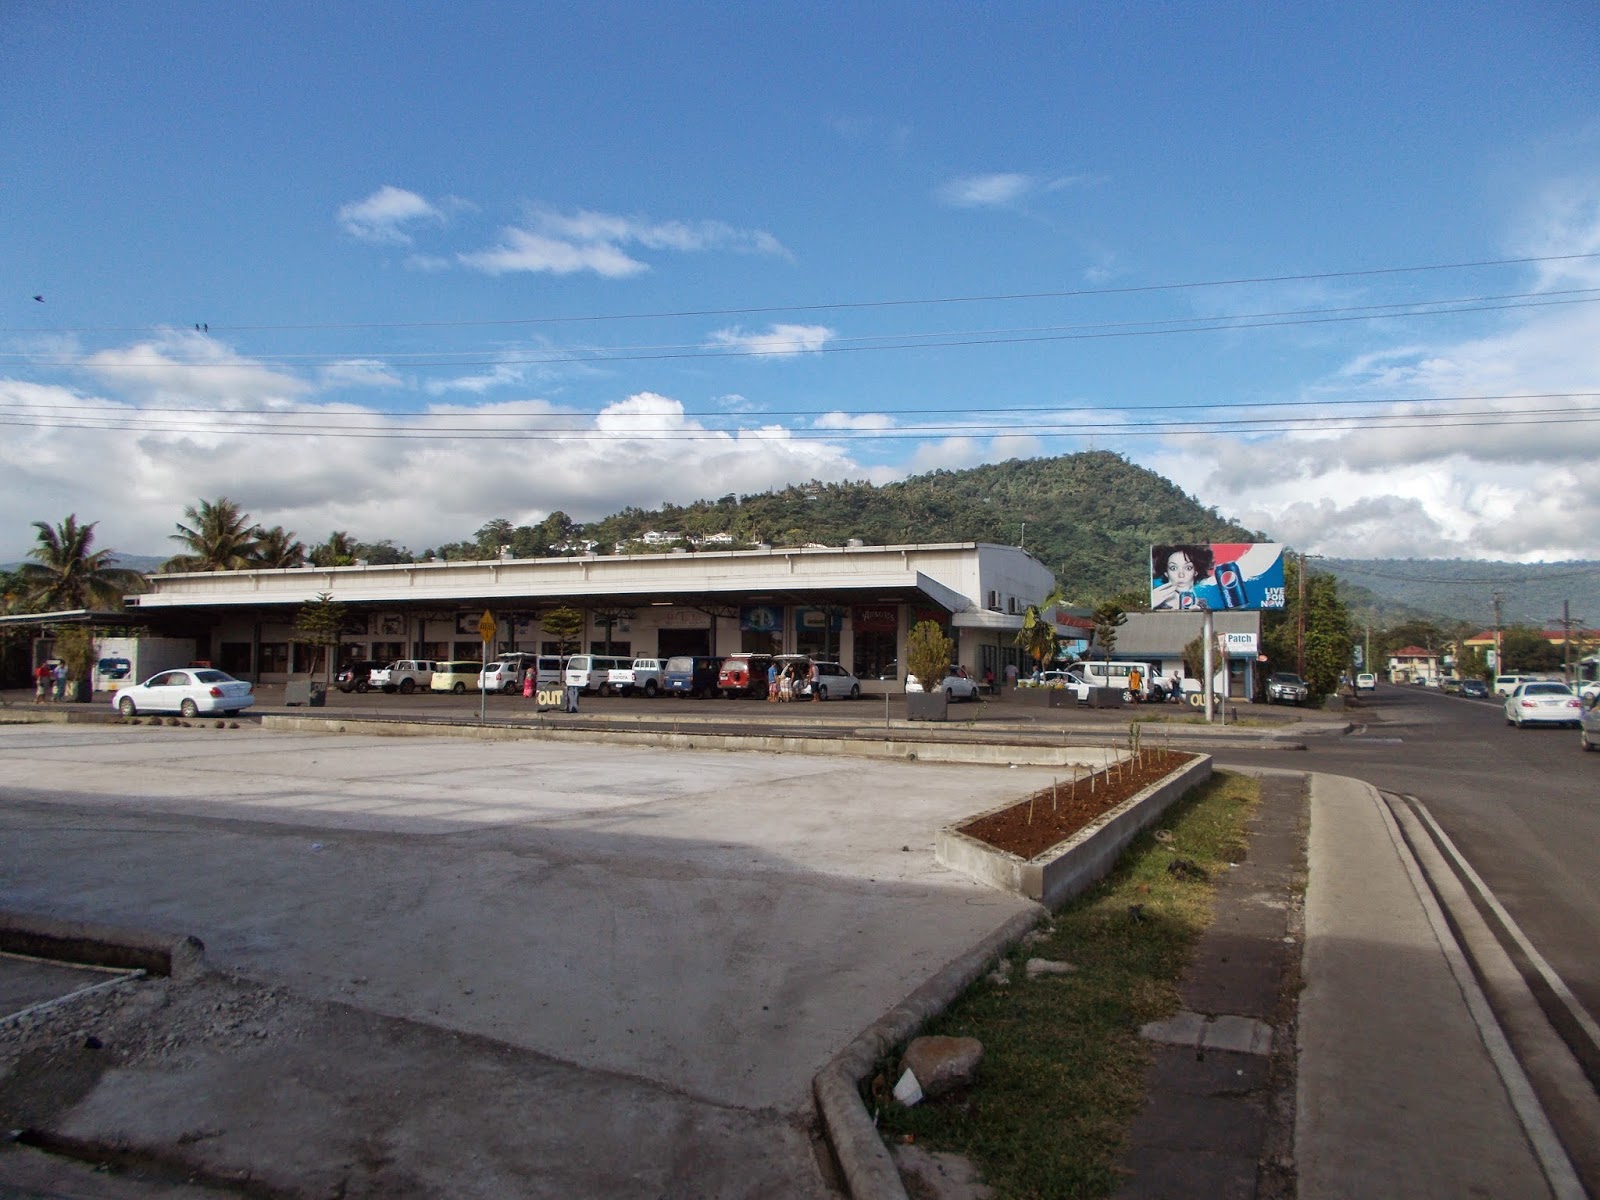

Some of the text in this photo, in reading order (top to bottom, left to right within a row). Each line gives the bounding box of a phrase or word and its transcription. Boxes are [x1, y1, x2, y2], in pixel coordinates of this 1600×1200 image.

[1260, 600, 1284, 608] NOW
[1228, 634, 1252, 643] Patch
[538, 690, 564, 706] OUT
[1190, 693, 1207, 707] OU
